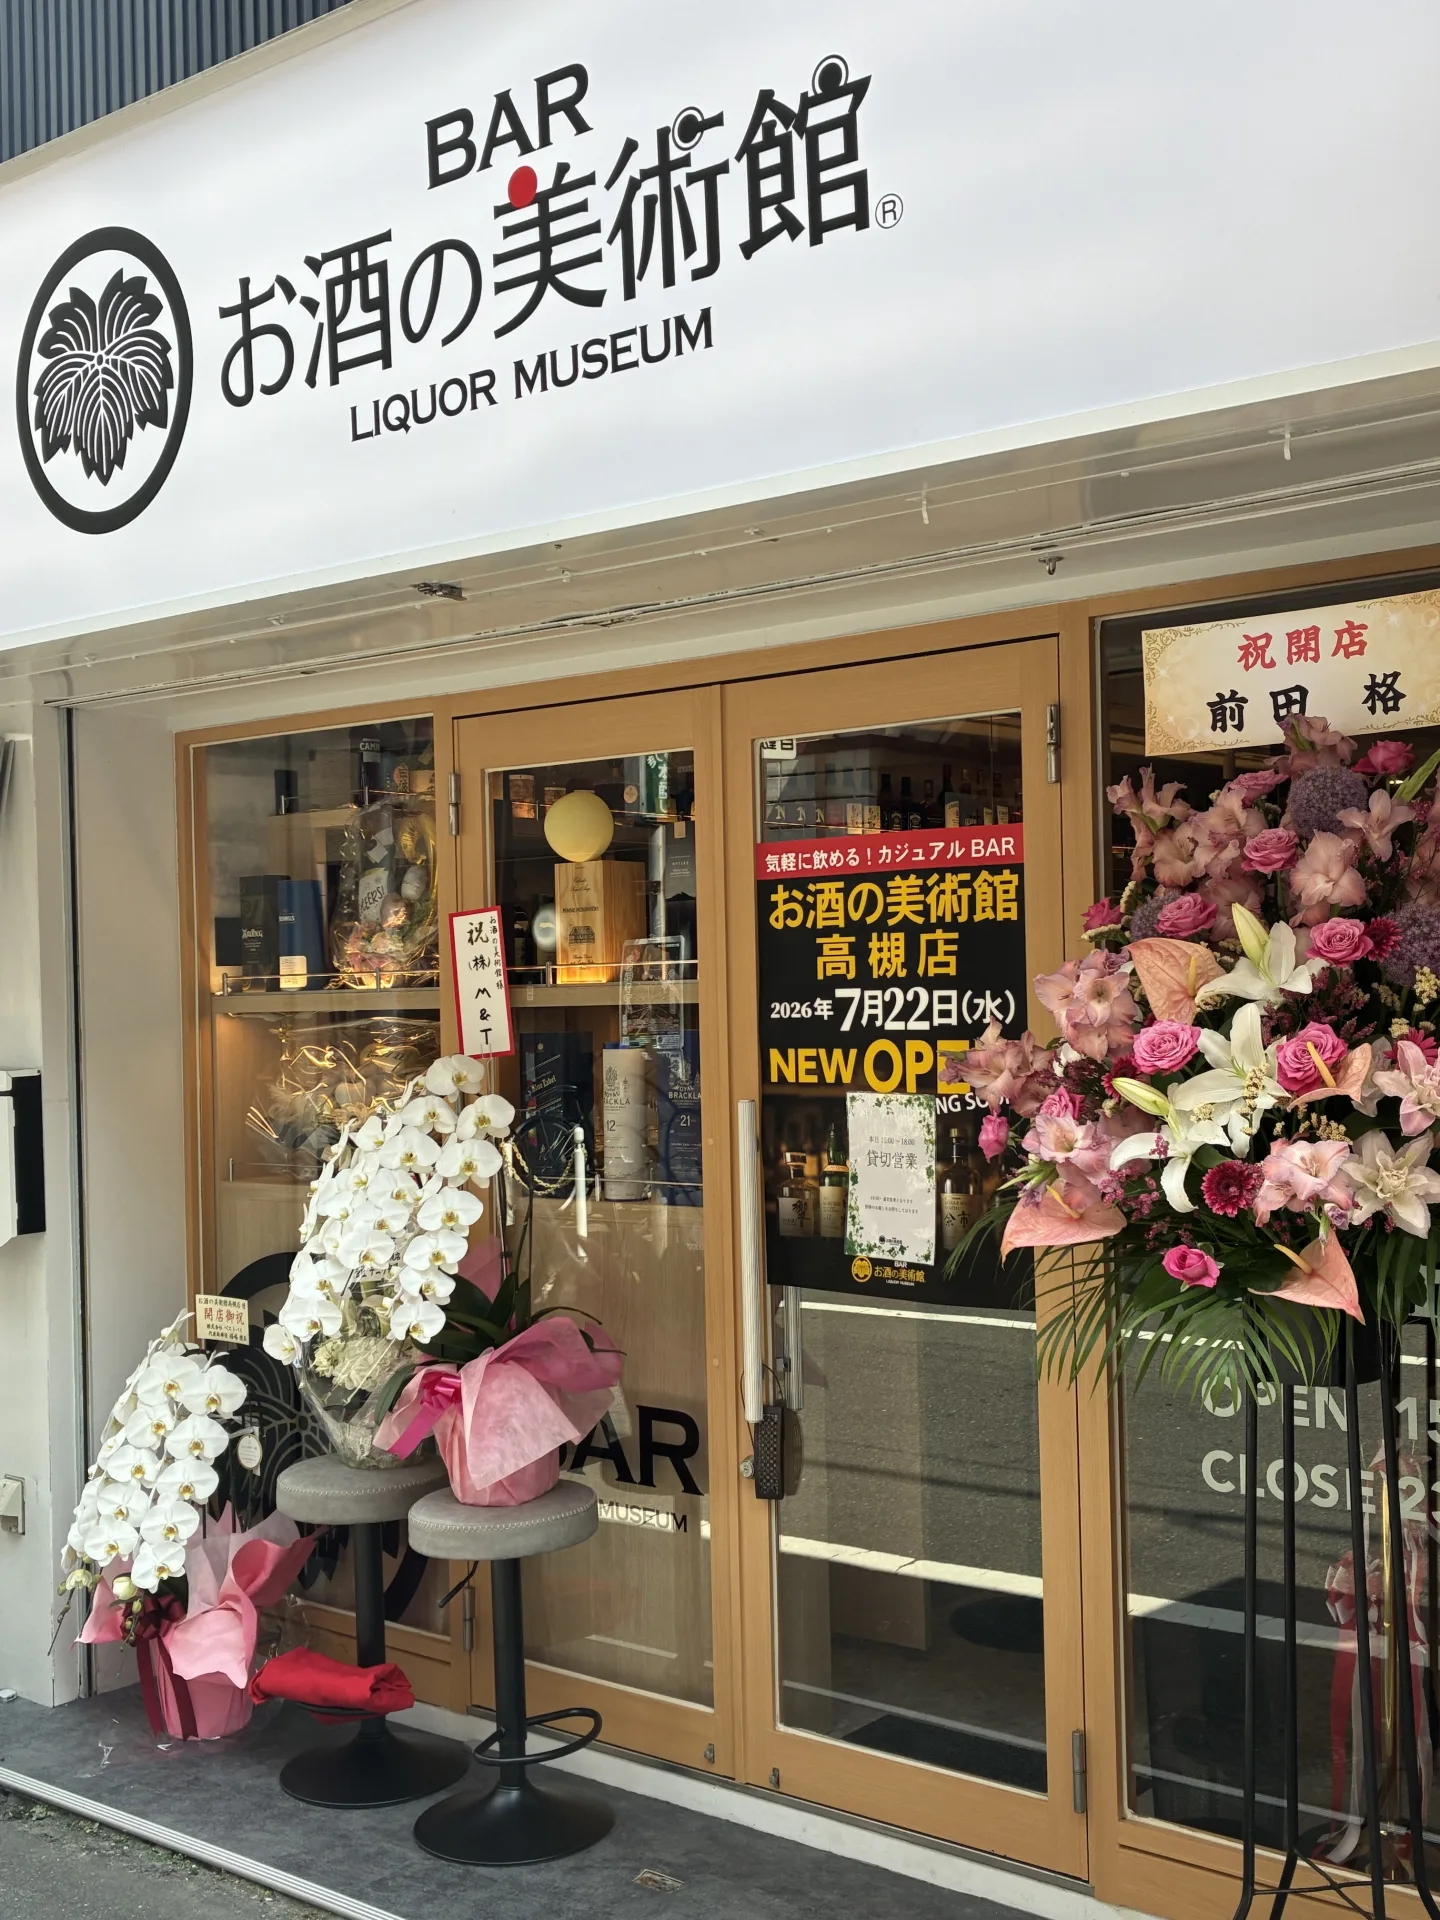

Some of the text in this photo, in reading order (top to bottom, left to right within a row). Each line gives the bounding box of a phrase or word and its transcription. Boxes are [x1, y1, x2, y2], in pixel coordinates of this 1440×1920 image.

[425, 62, 592, 190] BAR
[218, 54, 872, 408] お酒の美術館
[349, 306, 714, 443] LIQUOR MUSEUM
[1237, 619, 1370, 672] 祝開店
[970, 837, 1016, 858] BAR
[769, 869, 1019, 930] お酒の美術館
[815, 929, 960, 980] 高槻店
[769, 1038, 975, 1094] NEW OPE
[680, 1115, 691, 1127] 21
[866, 1149, 918, 1170] 貸切営業
[559, 1404, 704, 1497] AR
[1201, 1449, 1377, 1515] CLOSE
[598, 1498, 688, 1533] MUSEUM
